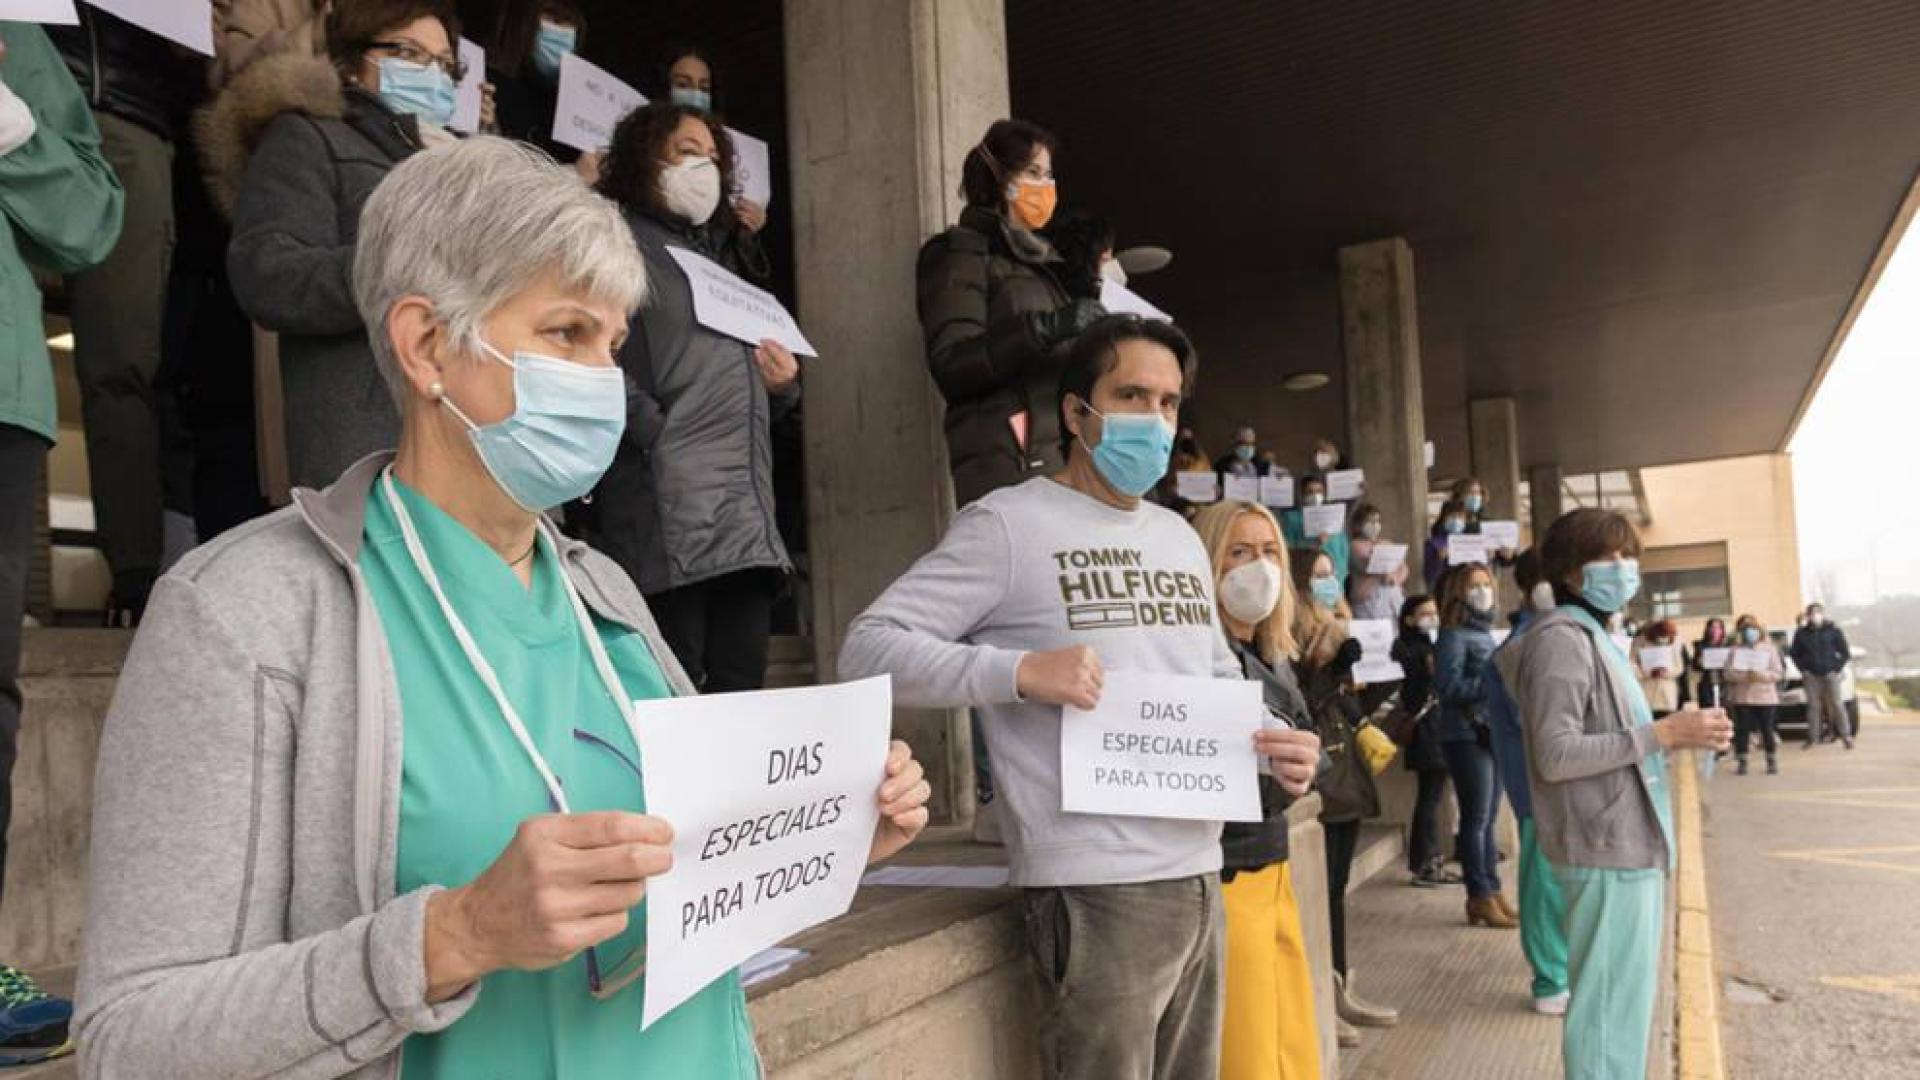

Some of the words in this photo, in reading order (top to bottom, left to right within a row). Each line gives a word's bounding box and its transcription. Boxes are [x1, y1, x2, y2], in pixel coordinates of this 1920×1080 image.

[1053, 548, 1142, 570] TOMMY
[1059, 570, 1208, 602] HILFIGER
[1140, 701, 1188, 722] DIAS
[1102, 732, 1218, 757] ESPECIALES
[766, 742, 824, 786] DIAS
[1095, 767, 1149, 787] PARA
[1154, 771, 1226, 792] TODOS
[700, 794, 846, 861] ESPECIALES
[681, 881, 744, 940] PARA
[754, 852, 835, 905] TODOS
